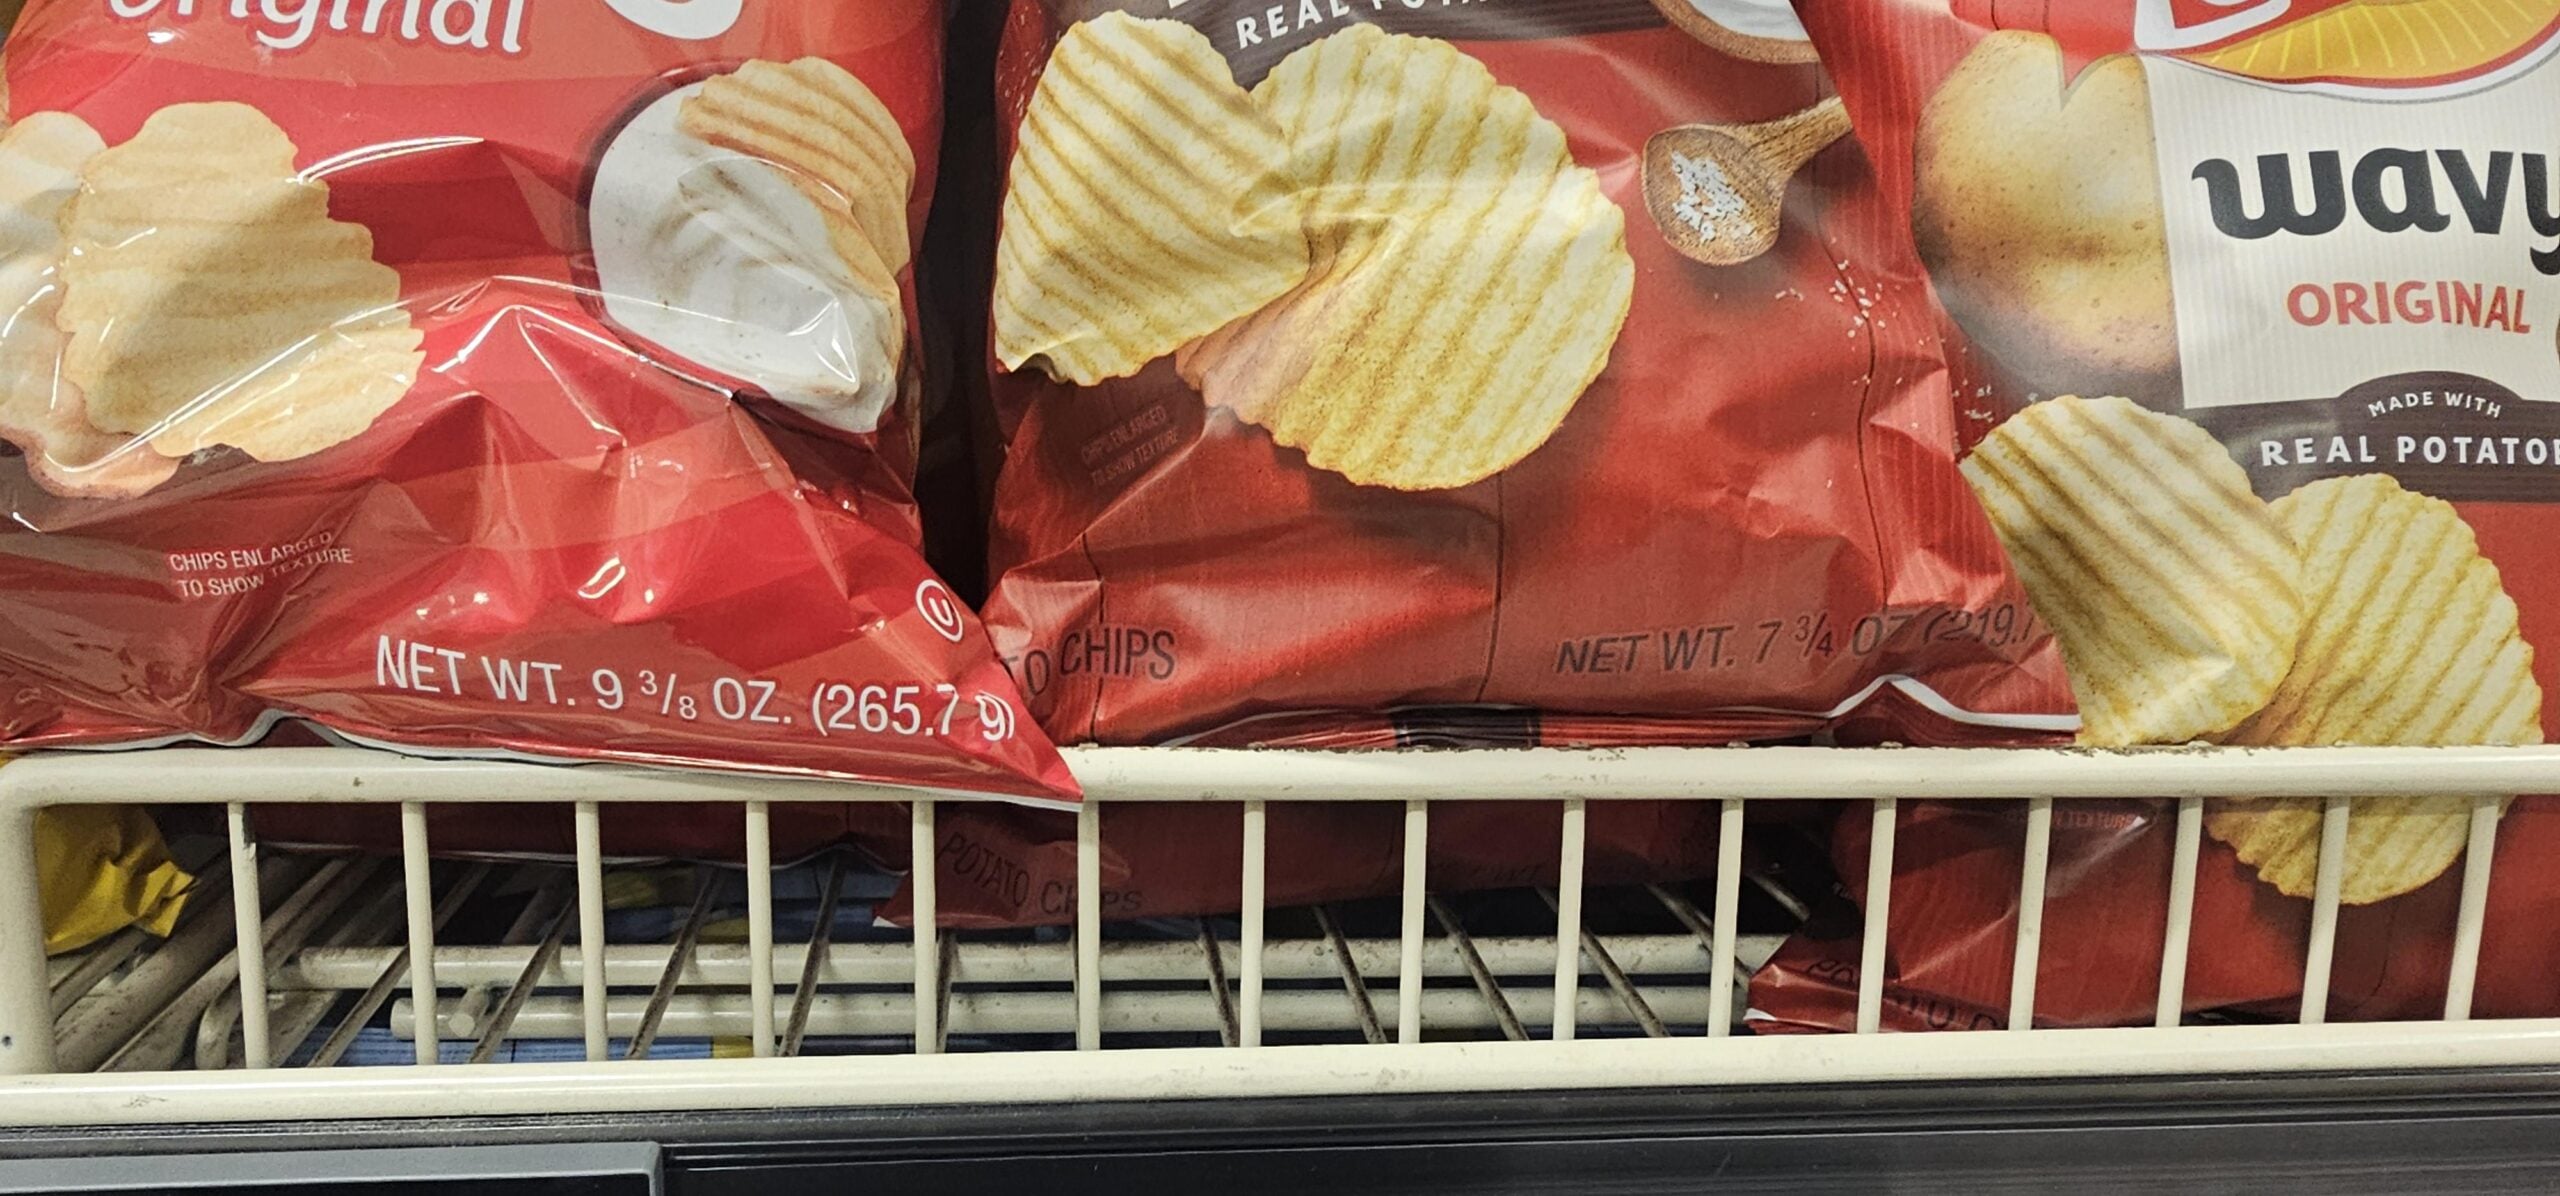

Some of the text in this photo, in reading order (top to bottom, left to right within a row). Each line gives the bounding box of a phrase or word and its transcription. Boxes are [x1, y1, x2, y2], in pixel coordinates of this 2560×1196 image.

[1235, 0, 1351, 49] REAL
[2286, 280, 2532, 335] ORIGINAL
[2367, 391, 2502, 419] MADE WITH
[2260, 435, 2377, 467] REAL
[169, 551, 228, 572] CHIPS
[177, 547, 354, 597] TO SHOW TEXTURE
[1059, 626, 1176, 681] CHIPS
[1555, 633, 1649, 674] NET
[1662, 624, 1735, 672] WT.
[1756, 621, 1784, 664] 7
[375, 634, 467, 696] NET
[480, 655, 576, 707] WT.
[592, 668, 625, 710] 9
[712, 677, 792, 725] OZ.
[936, 831, 1030, 908] POTATO
